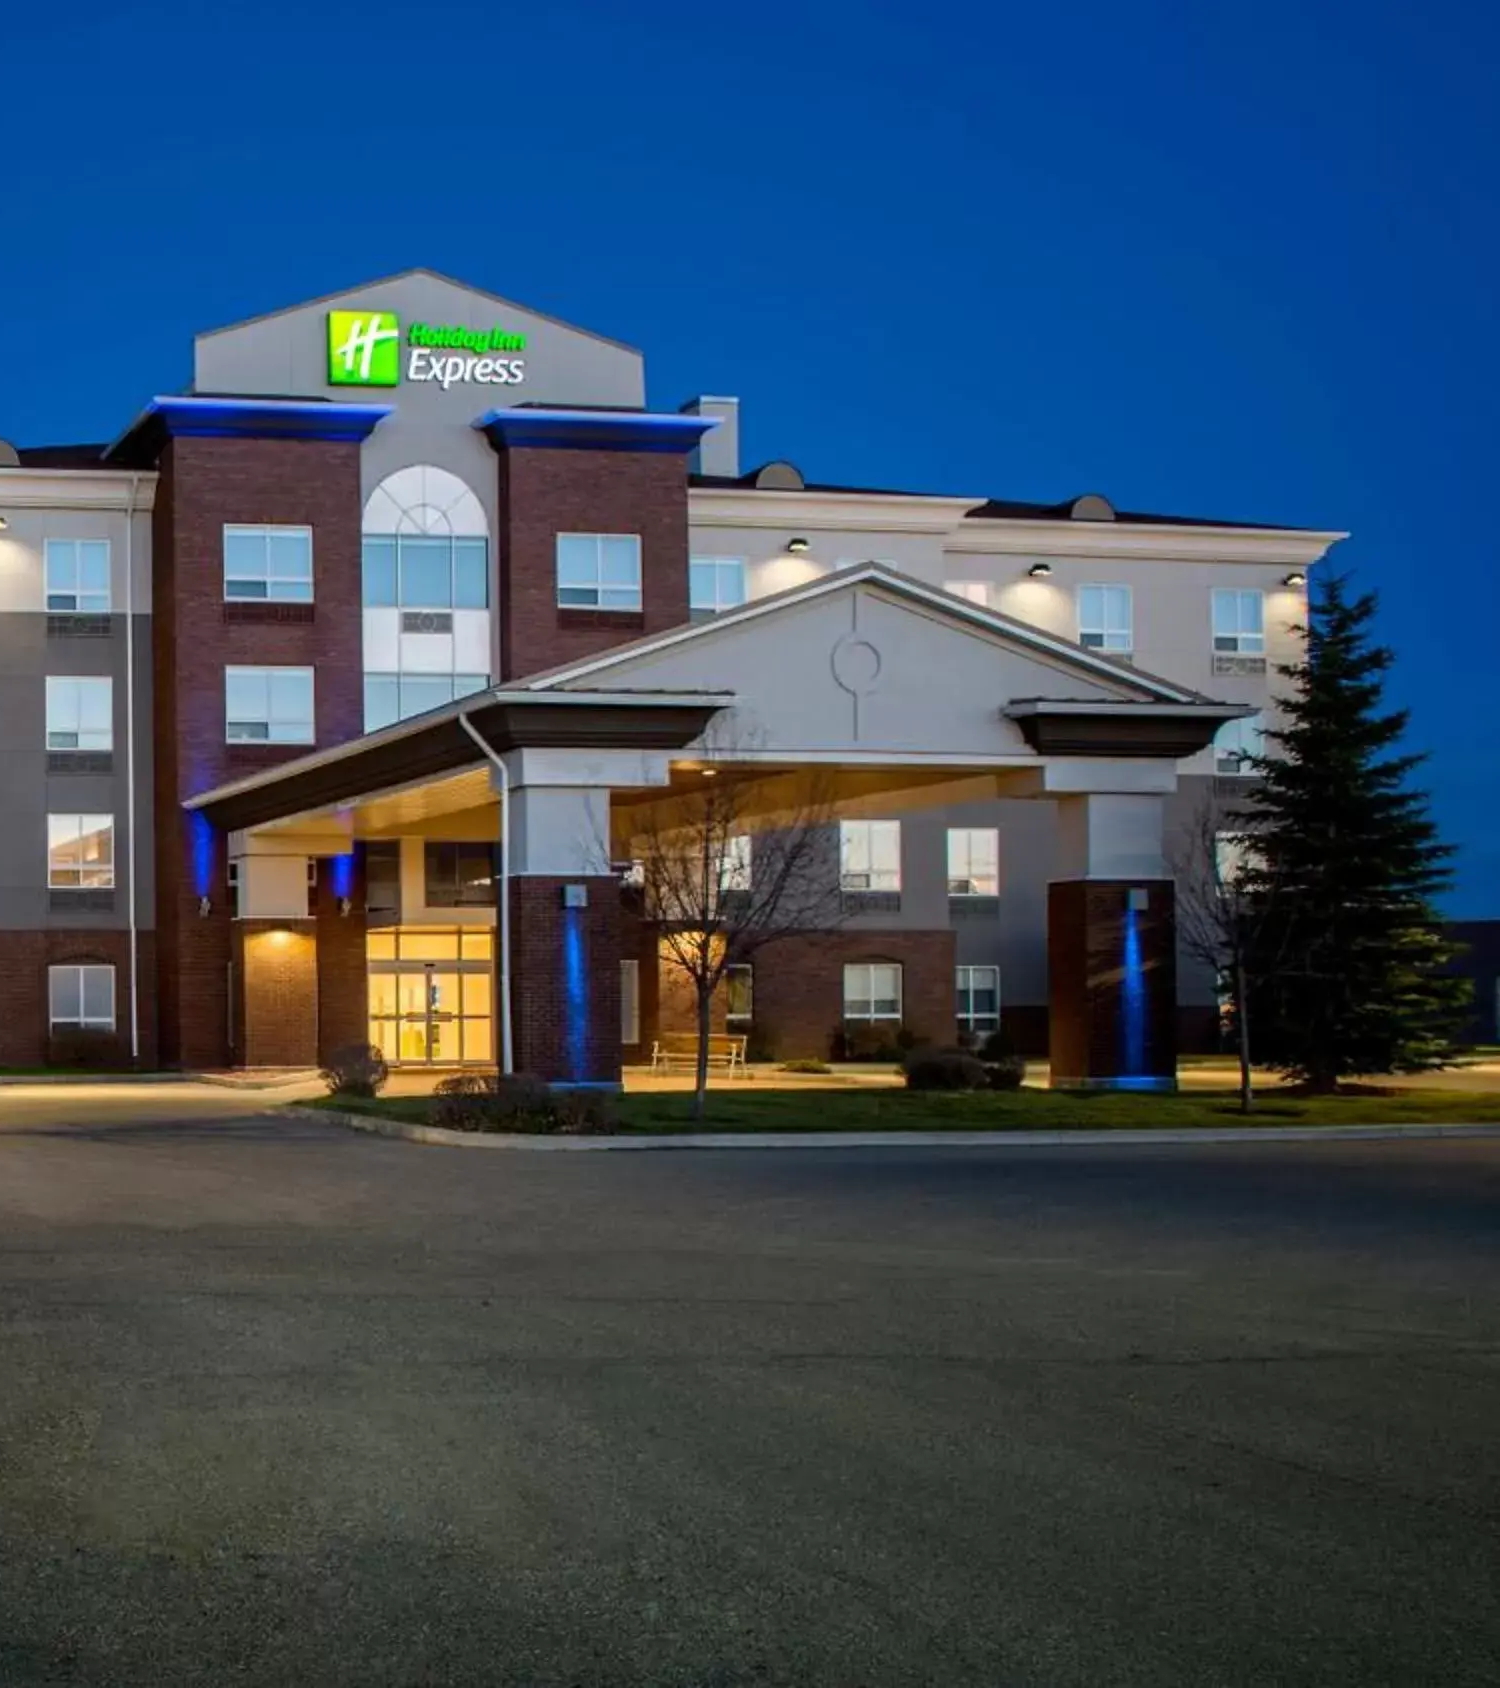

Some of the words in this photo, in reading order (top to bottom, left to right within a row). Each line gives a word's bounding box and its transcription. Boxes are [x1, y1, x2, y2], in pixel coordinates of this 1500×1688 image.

[409, 323, 489, 353] Holiday
[491, 327, 525, 351] Inn
[408, 348, 525, 390] Express
